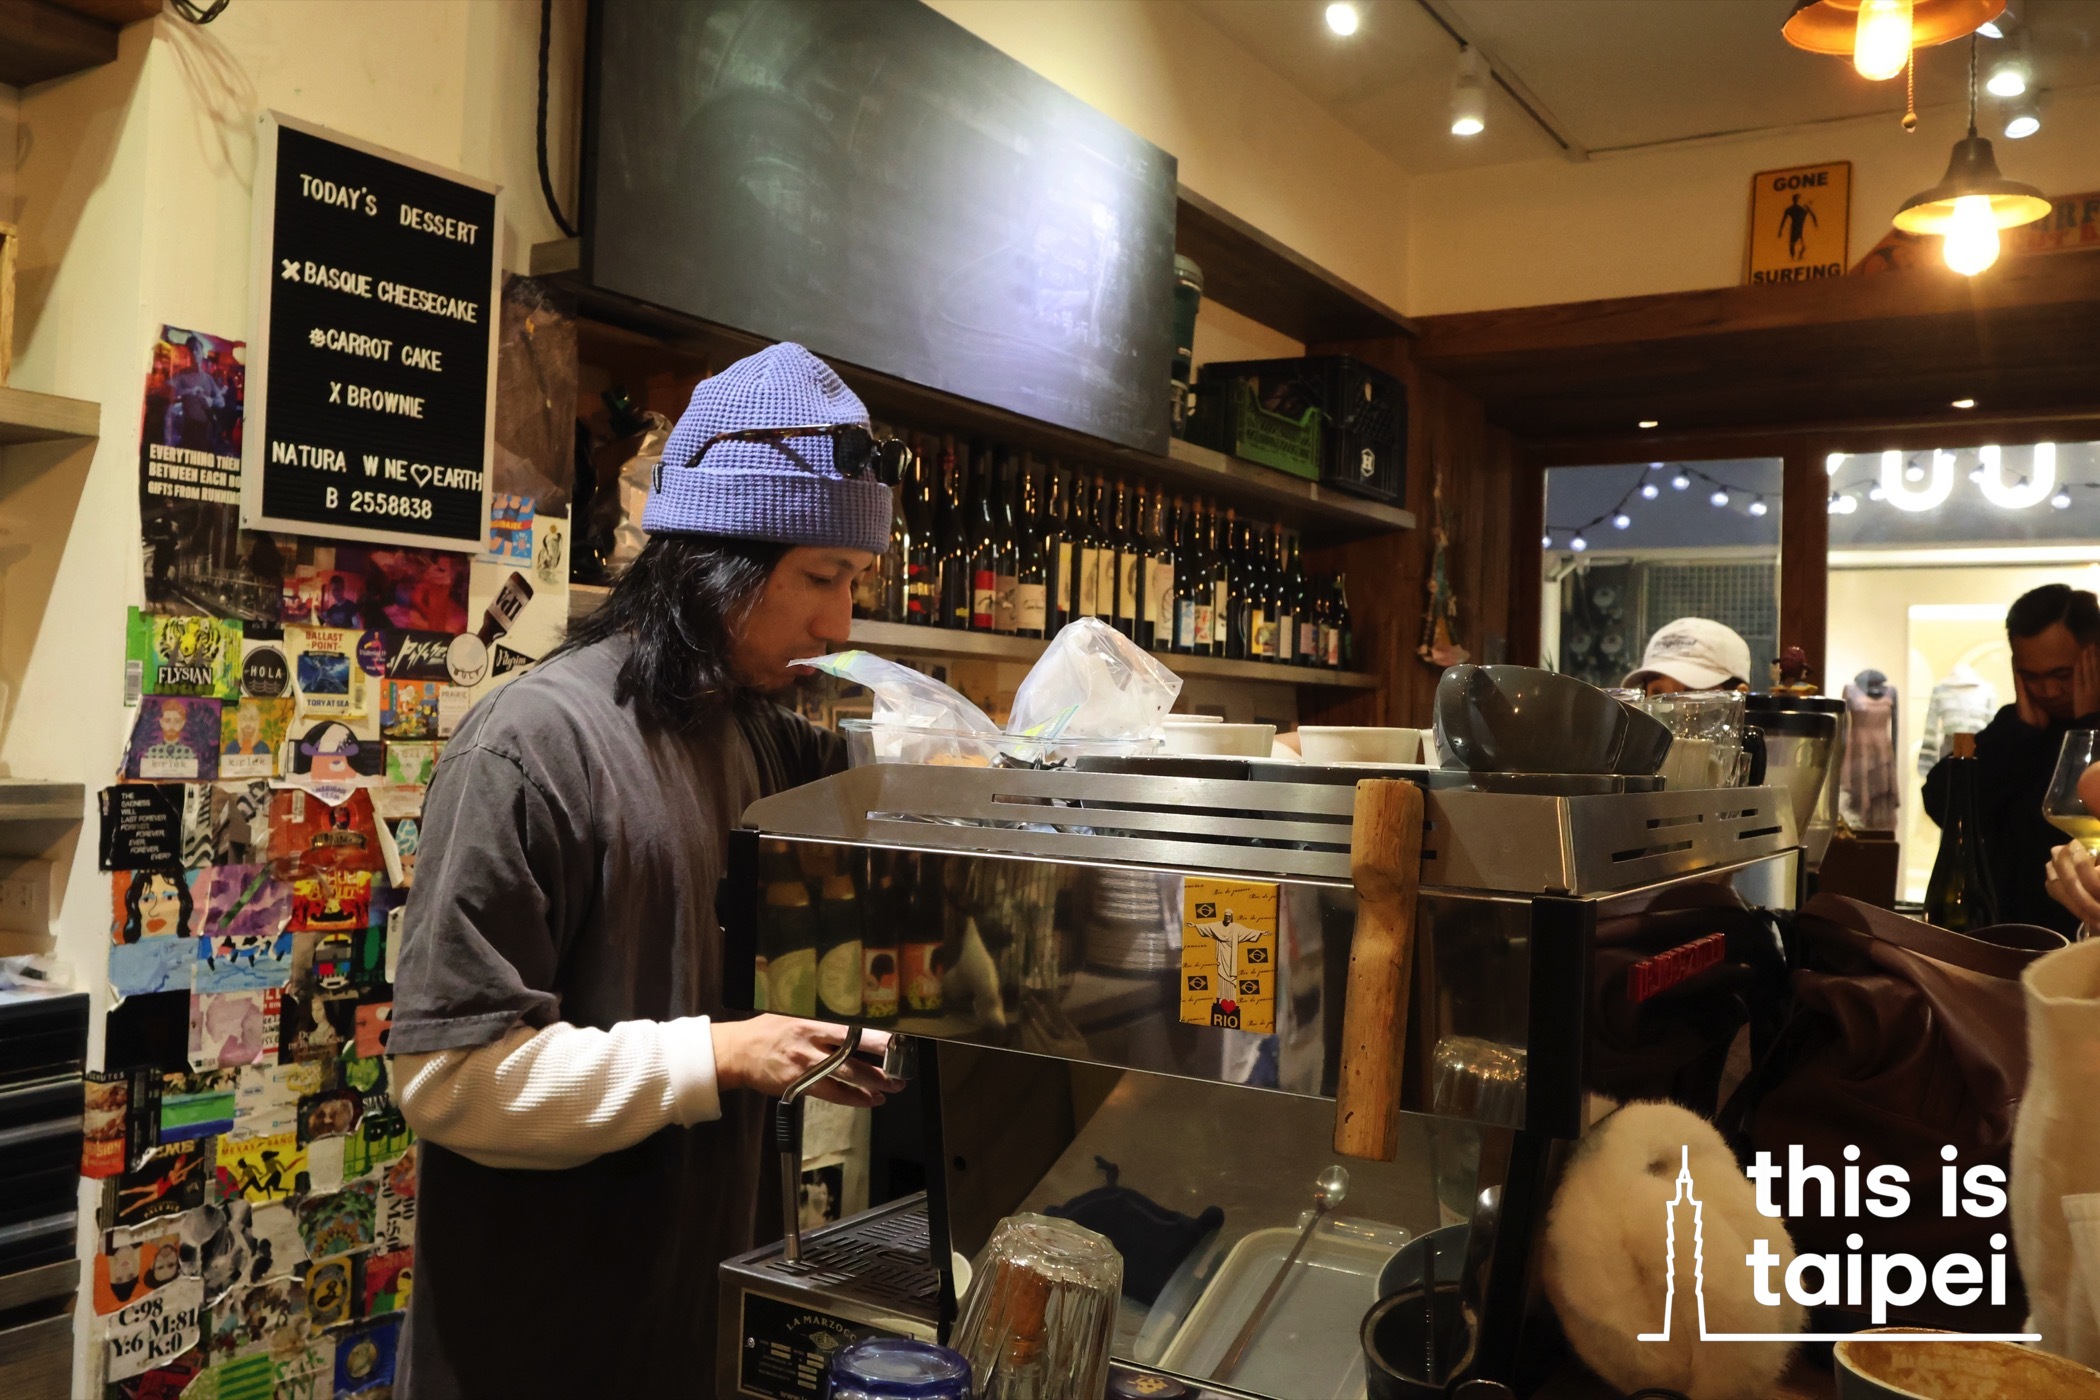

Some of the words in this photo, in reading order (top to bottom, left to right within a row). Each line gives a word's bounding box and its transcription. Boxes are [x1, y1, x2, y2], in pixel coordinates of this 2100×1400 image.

[1773, 171, 1829, 192] GONE
[300, 173, 378, 216] TODAY'S
[400, 204, 478, 245] DESSERT
[1753, 262, 1841, 285] SURFING
[304, 261, 372, 299] BASQUE
[378, 280, 478, 323] CHEESECAKE
[326, 329, 393, 362] CARROT
[401, 345, 442, 372] CAKE
[348, 384, 425, 419] BROWNIE
[150, 443, 215, 468] EVERYTHING
[272, 441, 347, 473] NATURA
[433, 464, 483, 492] EARTH
[149, 461, 199, 482] BETWEEN
[200, 469, 227, 486] EACH
[148, 481, 173, 496] GIFTS
[174, 484, 200, 500] FROM
[326, 487, 338, 509] B
[350, 490, 432, 520] 2558838
[305, 631, 343, 642] BALLAST
[311, 641, 338, 650] POINT
[250, 665, 282, 679] HOLA
[121, 792, 134, 800] THE
[1214, 1014, 1238, 1028] RIO
[786, 1317, 801, 1331] LA
[803, 1315, 857, 1342] MARZOCC
[111, 1331, 143, 1358] Y:6
[148, 1333, 182, 1359] K:0
